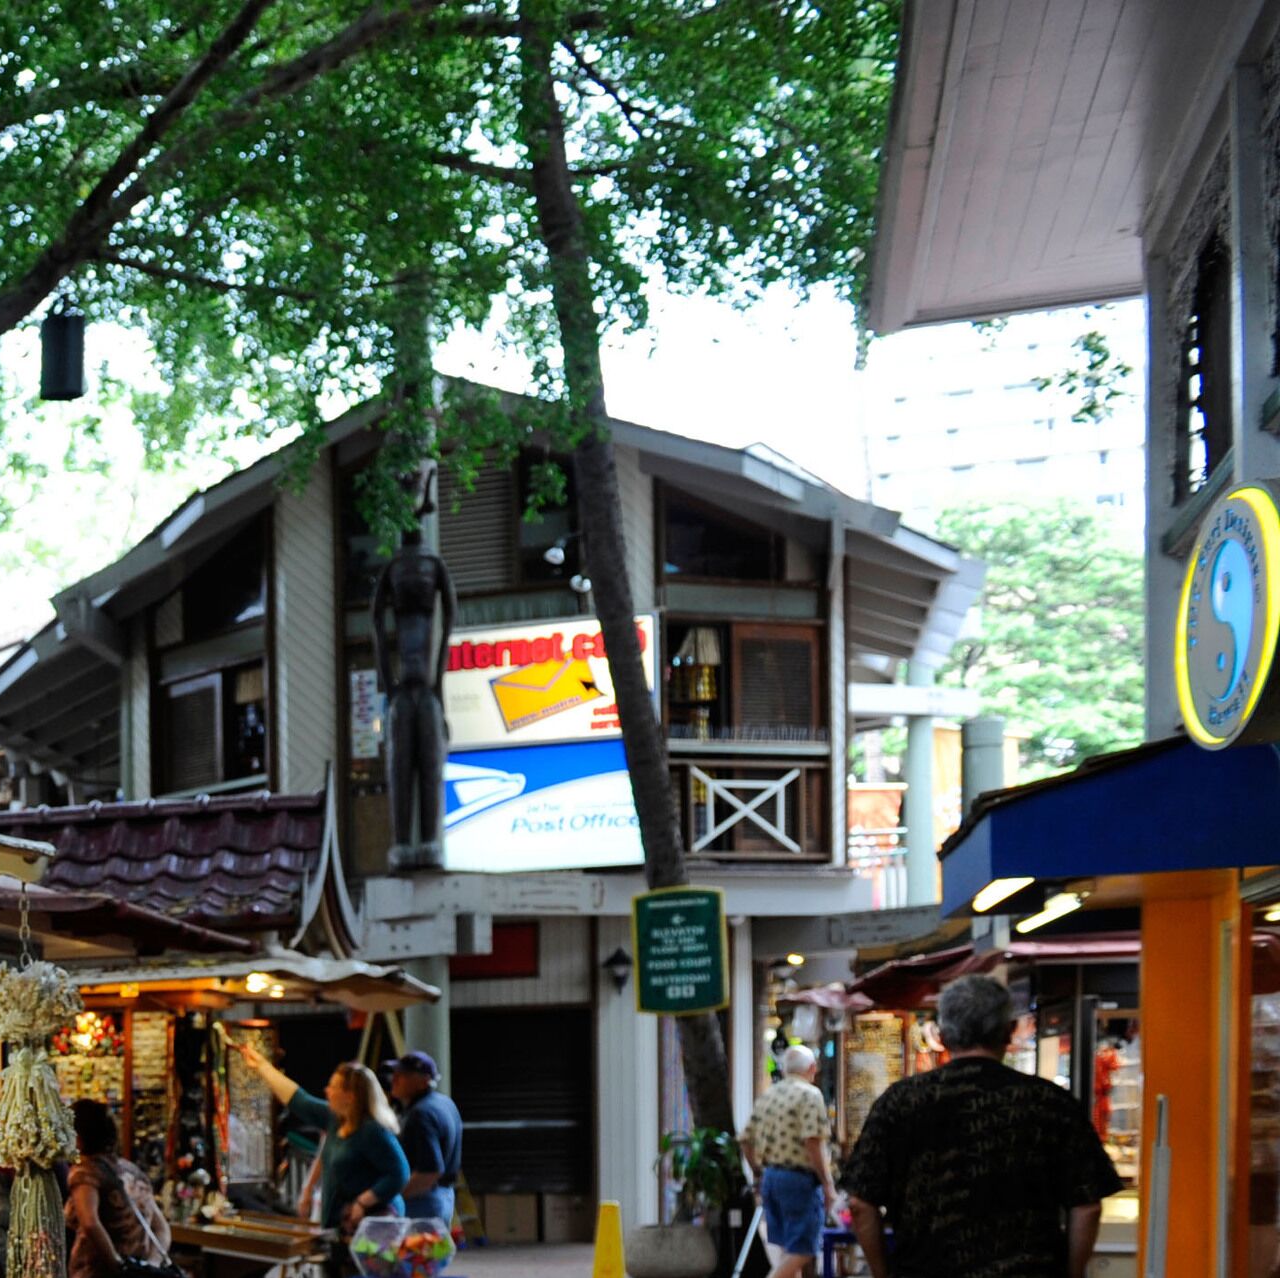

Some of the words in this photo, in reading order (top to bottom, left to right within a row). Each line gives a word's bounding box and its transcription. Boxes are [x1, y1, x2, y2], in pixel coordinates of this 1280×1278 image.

[511, 817, 565, 834] Post
[648, 959, 677, 970] FOOD
[679, 956, 712, 968] COURT
